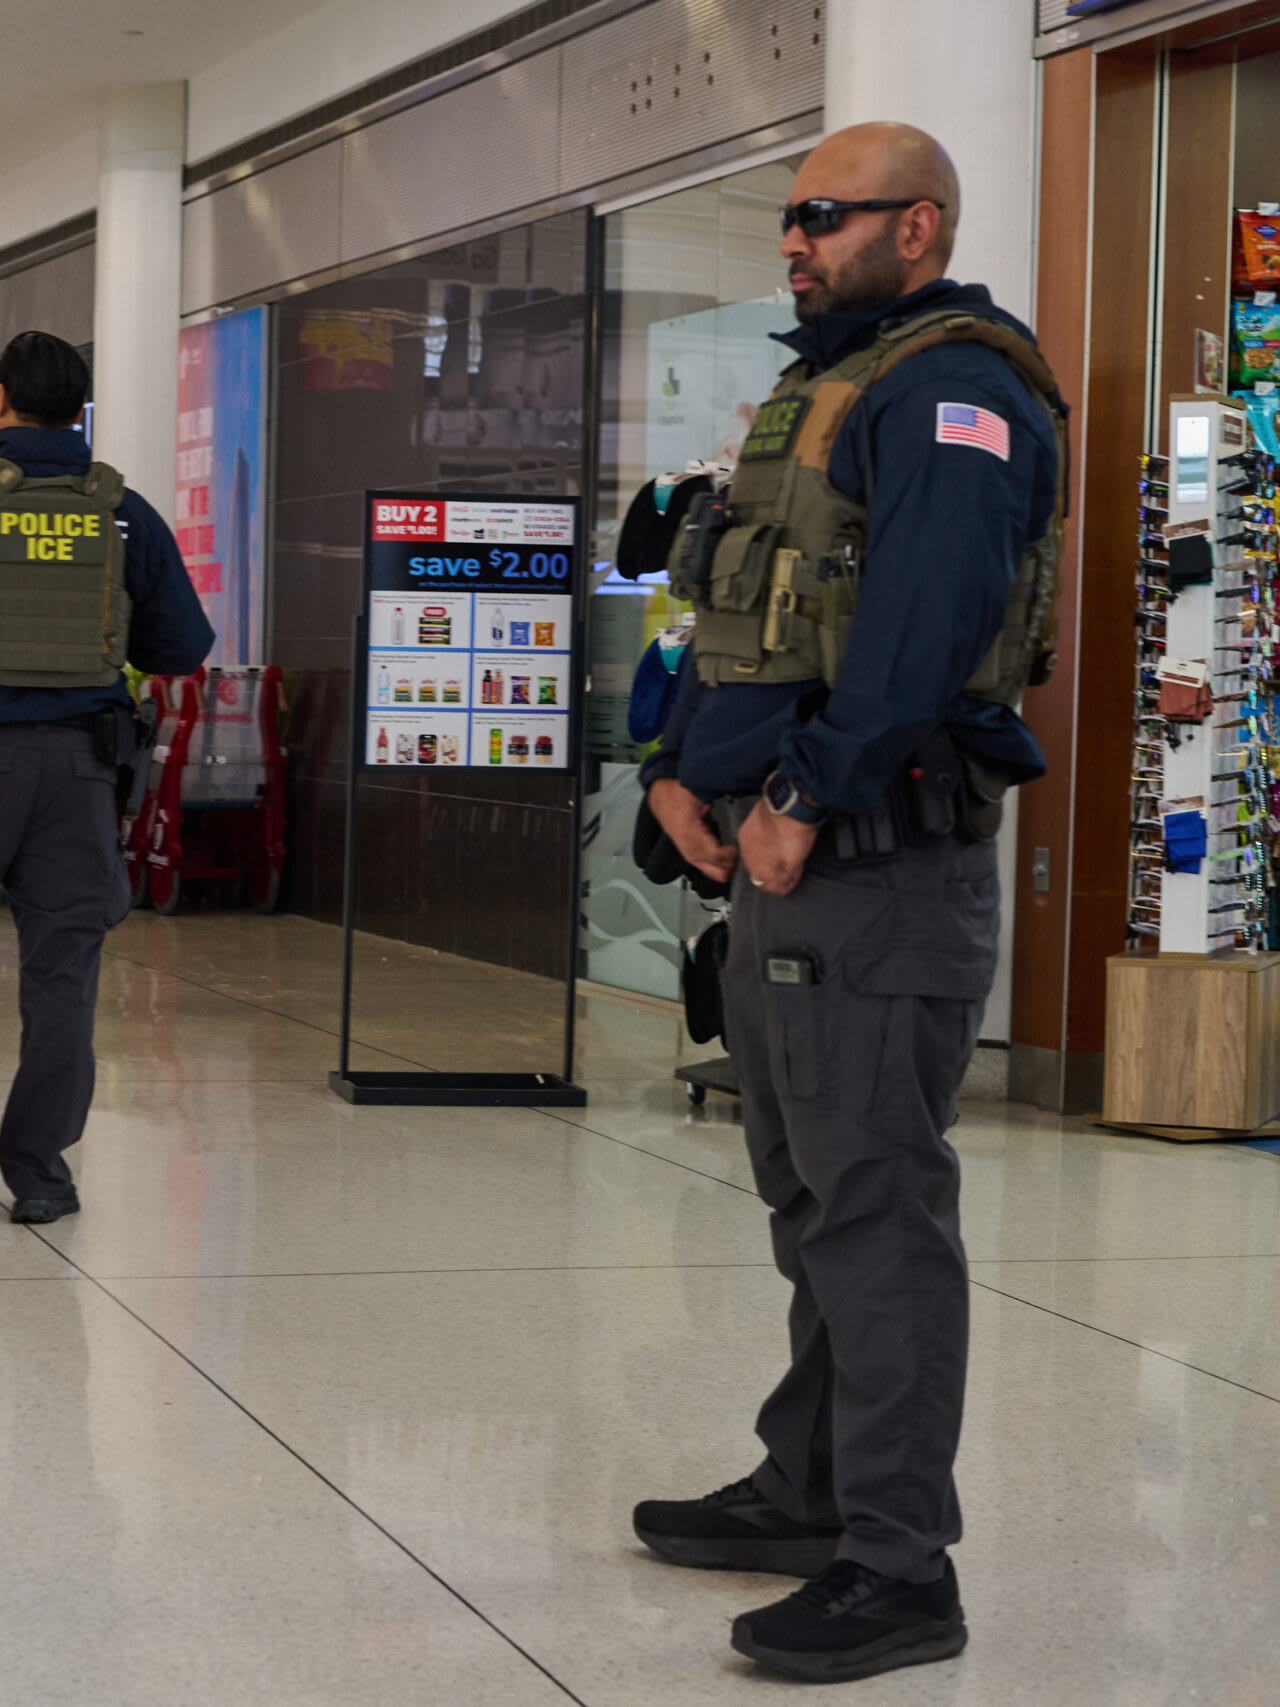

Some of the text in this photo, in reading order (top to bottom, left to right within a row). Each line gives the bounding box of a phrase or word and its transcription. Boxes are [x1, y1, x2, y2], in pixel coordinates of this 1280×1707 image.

[0, 512, 101, 537] POLICE
[376, 505, 438, 523] BUY 2
[376, 525, 407, 534] SAVE
[26, 537, 74, 561] ICE
[408, 548, 569, 579] save $2.00
